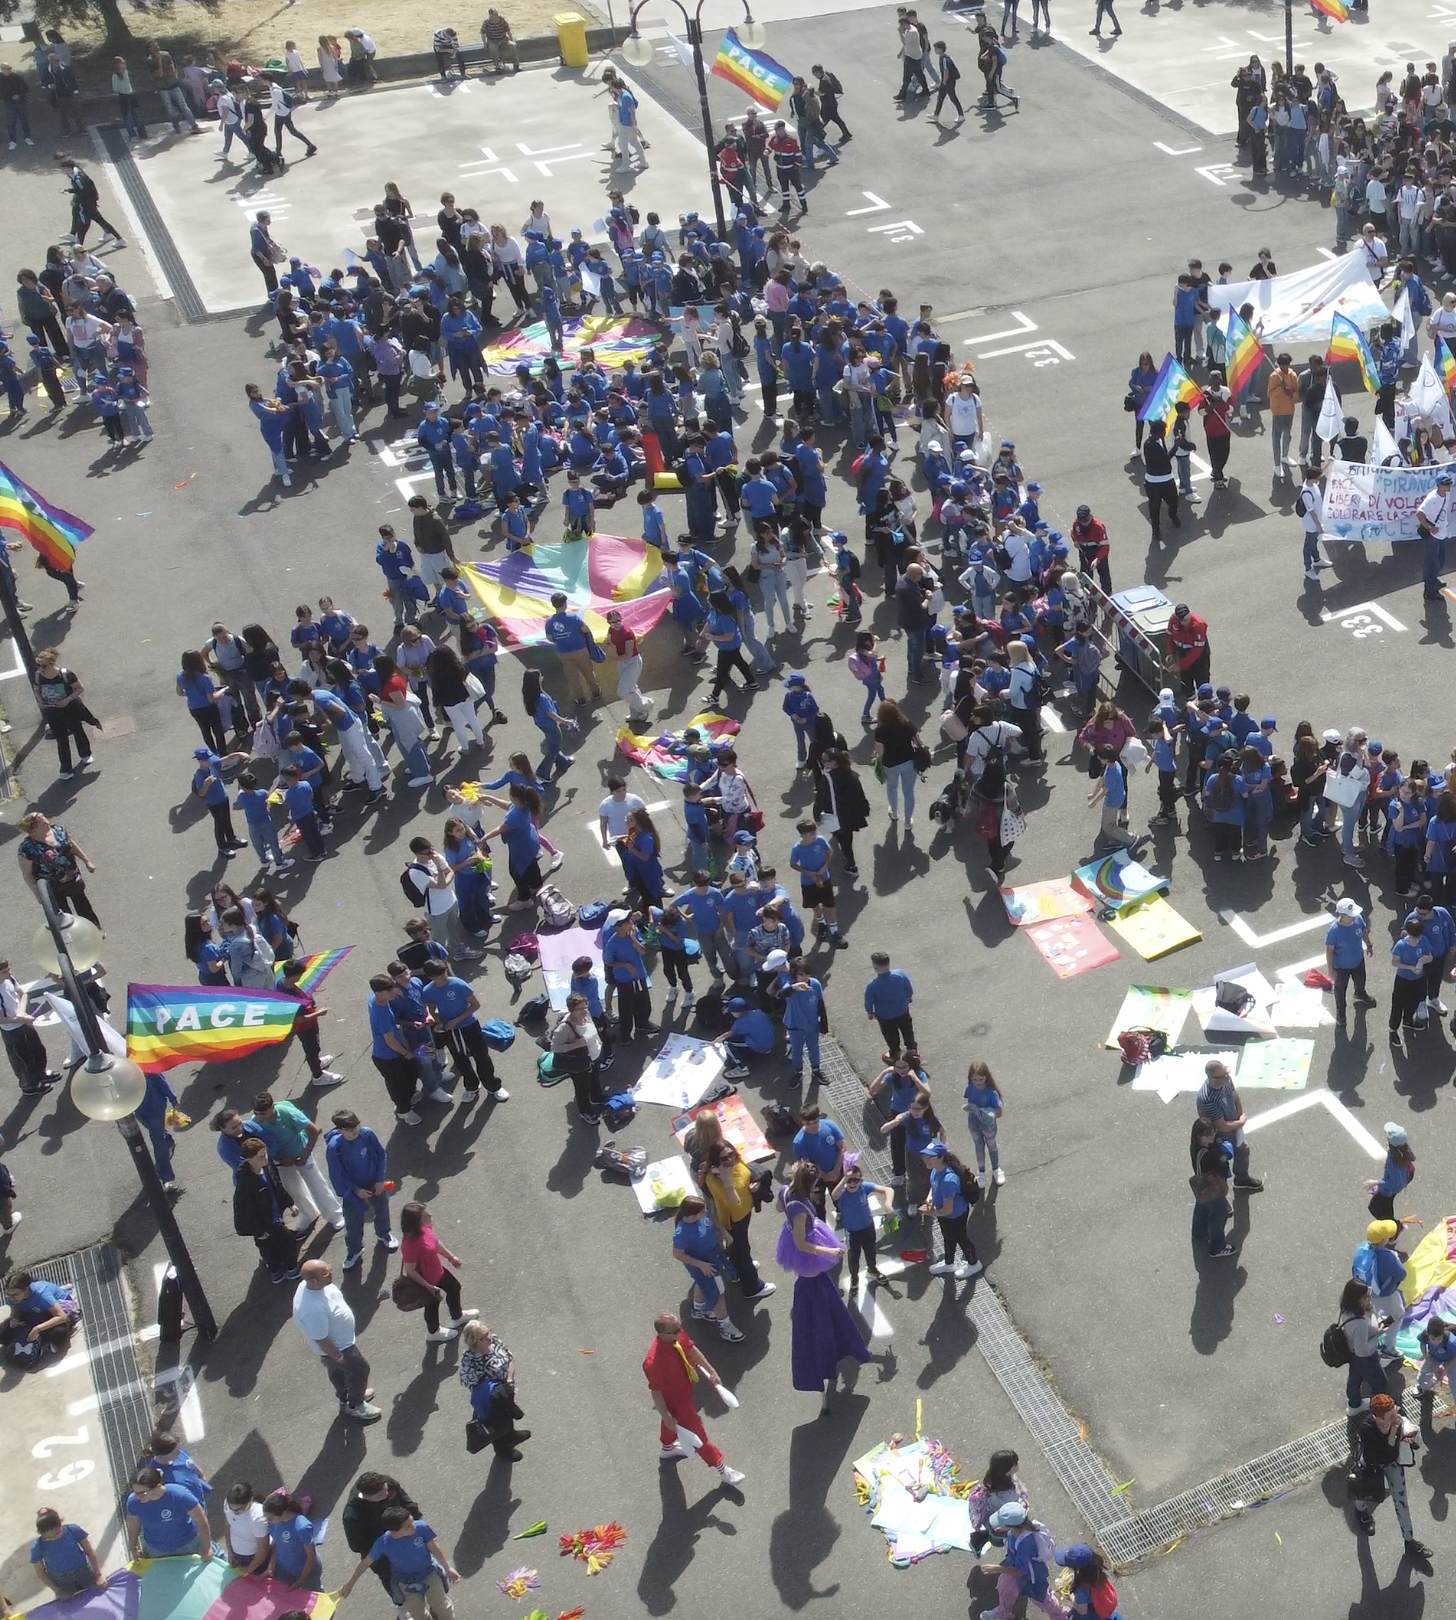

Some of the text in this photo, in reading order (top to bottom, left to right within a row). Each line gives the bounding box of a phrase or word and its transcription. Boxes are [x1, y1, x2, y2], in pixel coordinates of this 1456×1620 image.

[727, 46, 779, 89] PACE
[883, 228, 915, 243] 31
[1024, 348, 1061, 367] 32
[1341, 614, 1384, 638] 33
[154, 1003, 269, 1034] PACE
[31, 1424, 96, 1491] 62
